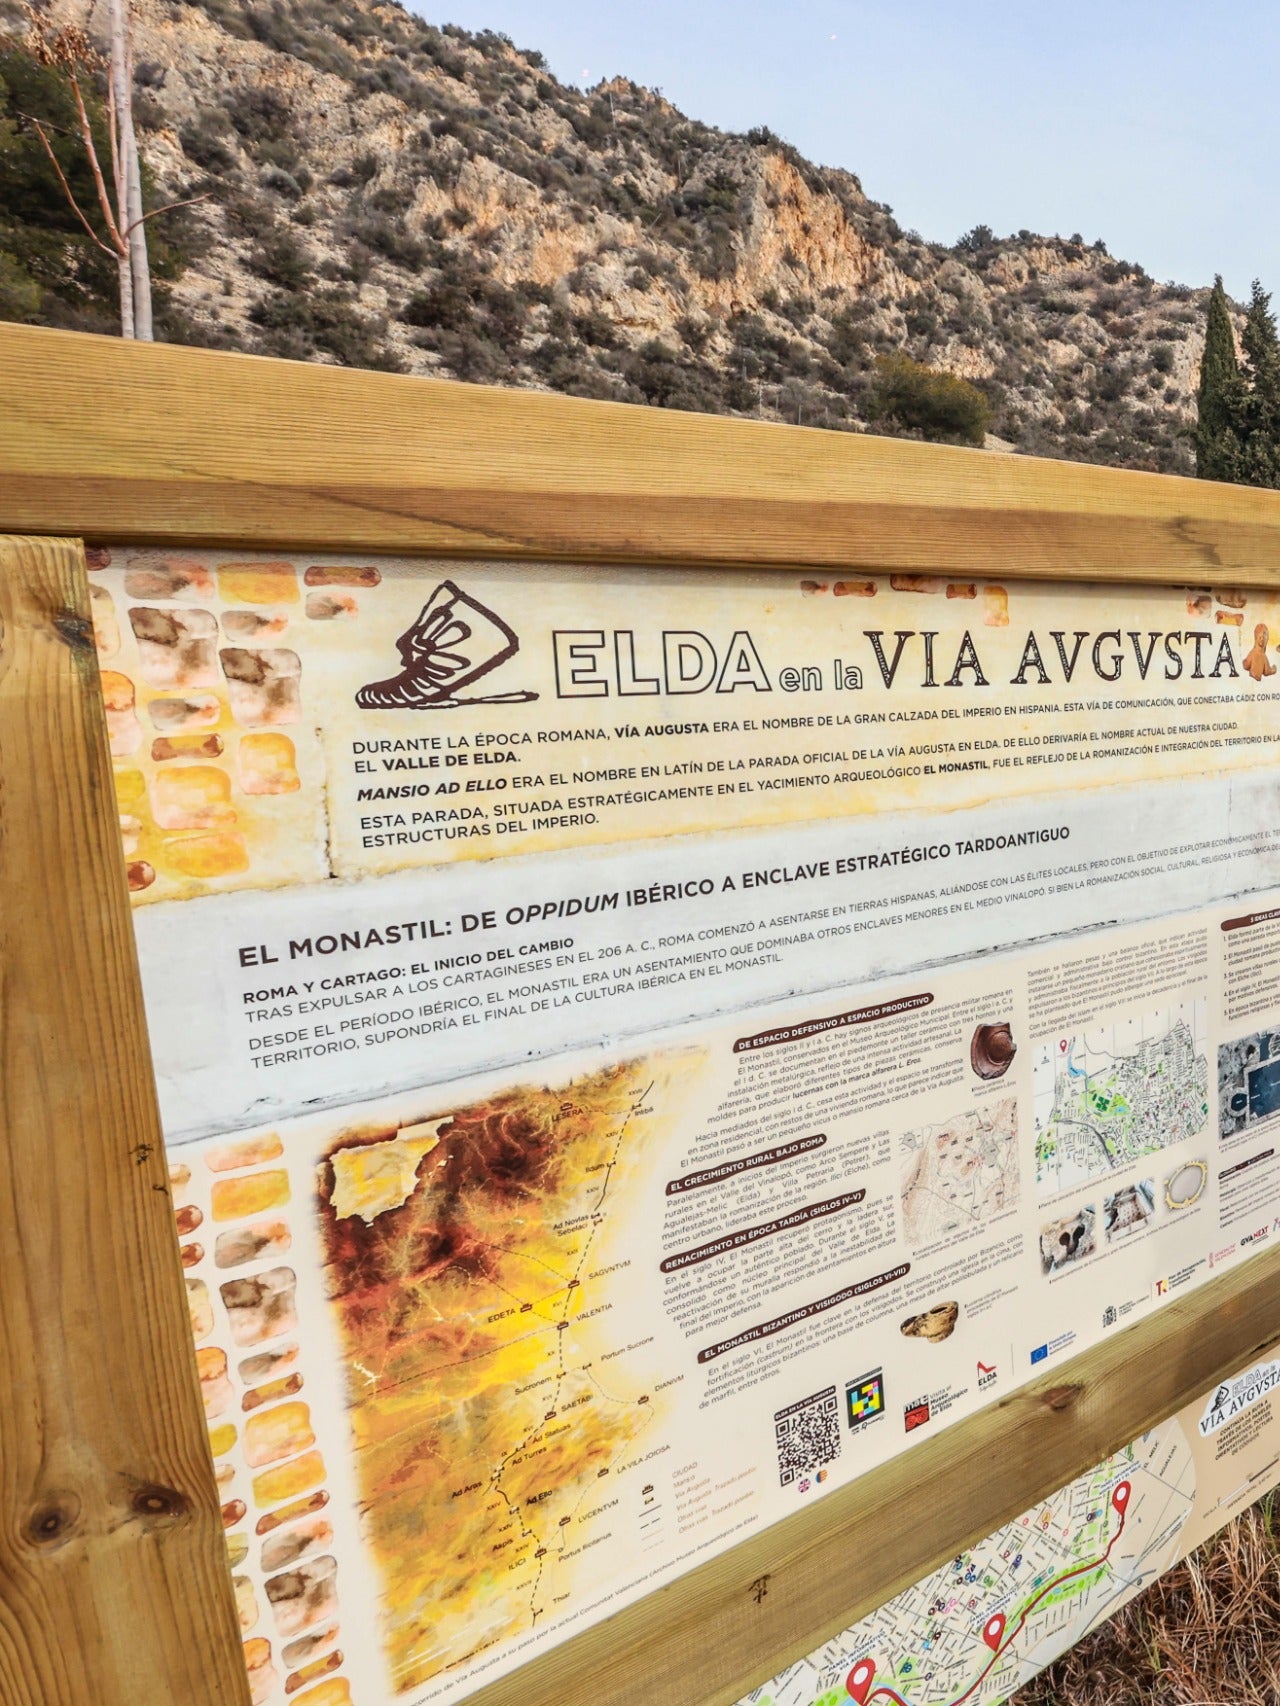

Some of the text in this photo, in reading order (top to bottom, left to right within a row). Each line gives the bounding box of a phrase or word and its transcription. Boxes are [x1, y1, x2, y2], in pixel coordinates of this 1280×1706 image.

[552, 629, 1240, 699] ELDA en la VIA AVGVSTA
[352, 703, 1063, 754] DURANTE LA ÉPOCA ROMANA, VÍA AUGUSTA ERA EL NOMBRE DE LA GRAN CALZADA DEL IMPERIO EN HISPANIA.
[354, 750, 523, 773] EL VALLE DE ELDA.
[356, 739, 1002, 801] MANSIO AD ELLO ERA EL NOMBRE EN LATÍN DE LA PARADA OFICIAL DE LA VÍA AUGUSTA EN ELDA.
[360, 760, 992, 829] ESTA PARADA, SITUADA ESTRATÉGICAMENTE EN EL YACIMIENTO ARQUEOLÓGICO EL MONASTIL,
[362, 812, 601, 848] ESTRUCTURAS DEL IMPERIO.
[238, 826, 1069, 967] EL MONASTIL: DE OPPIDUM IBÉRICO A ENCLAVE ESTRATÉGICO TARDOANTIGUO
[242, 937, 574, 1004] ROMA Y CARTAGO: EL INICIO DEL CAMBIO
[244, 945, 621, 1022] TRAS EXPULSAR A LOS CARTAGINESES EN EL 206
[248, 994, 484, 1050] DESDE EL PERÍODO IBÉRICO,
[250, 953, 785, 1068] TERRITORIO, SUPONDRÍA EL FINAL DE LA CULTURA IBÉRICA EN EL MONASTIL.
[738, 997, 929, 1050] DE ESPACIO DEFENSIVO A ESPACIO PRODUCTIVO
[671, 1135, 824, 1191] EL CRECIMIENTO RURAL BAJO ROMA
[665, 1192, 862, 1270] RENACIMIENTO EN ÉPOCA TARDÍA (SIGLOS IV-V)
[487, 1308, 516, 1323] EDETA
[576, 1303, 613, 1321] VALENTIA
[704, 1266, 906, 1358] EL MONASTIL BIZANTINO Y VISIGODO (SIGLOS VI-VII)
[978, 1371, 998, 1387] ELDA
[1200, 1411, 1225, 1434] VIA
